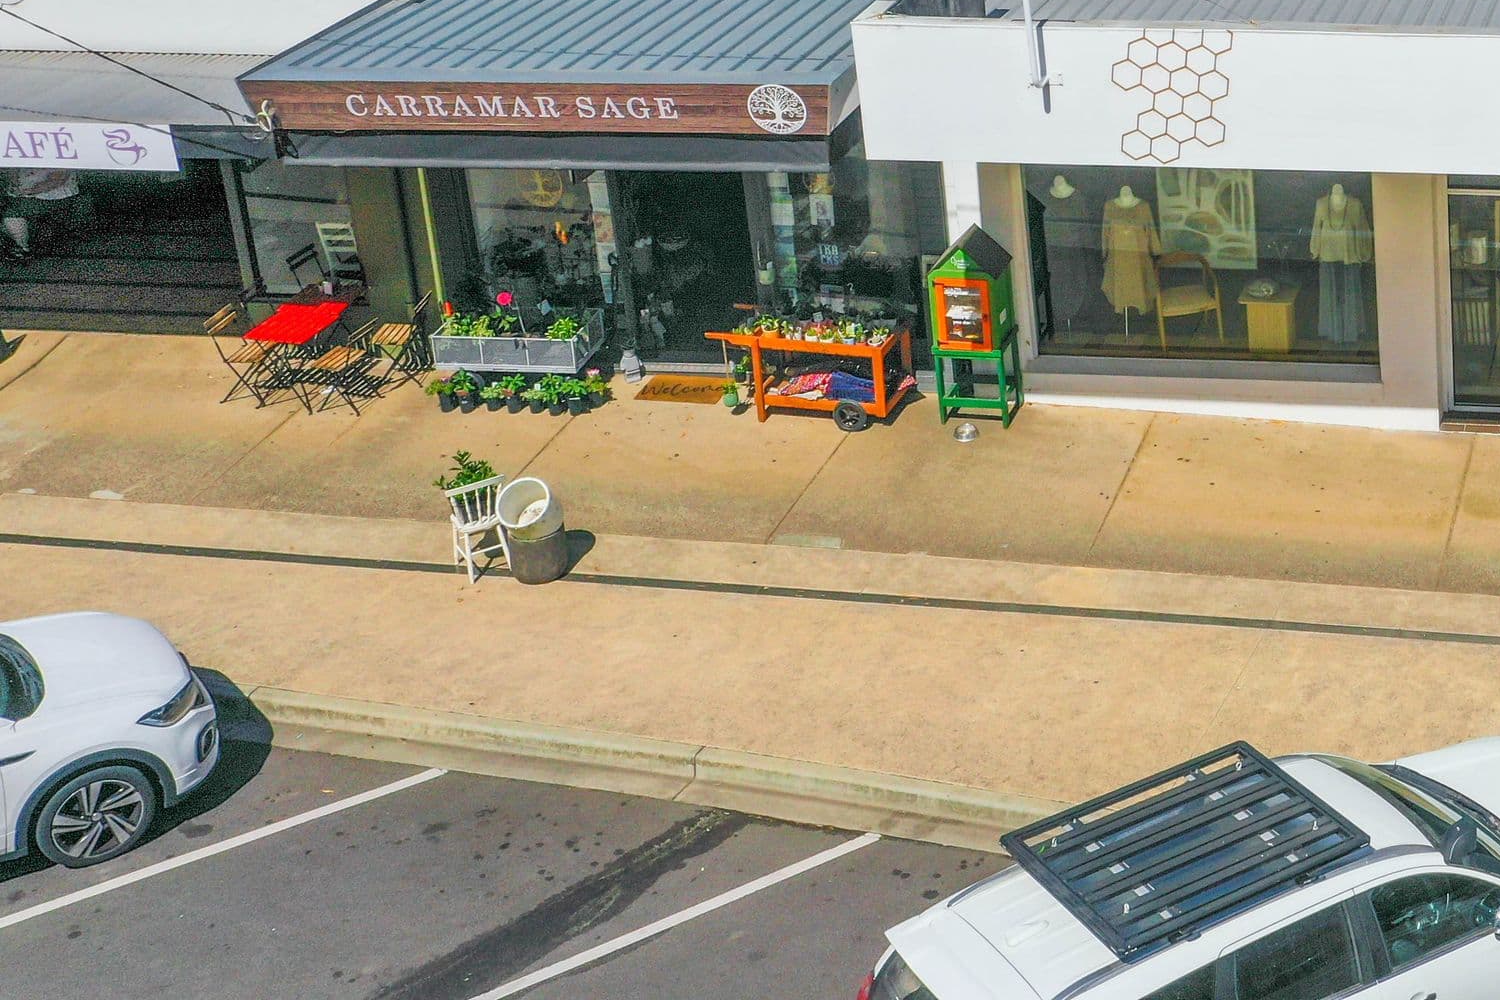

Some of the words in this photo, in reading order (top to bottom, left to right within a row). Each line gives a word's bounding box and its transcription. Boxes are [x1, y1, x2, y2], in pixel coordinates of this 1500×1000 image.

[345, 94, 561, 118] CARRAMAR
[575, 96, 679, 120] SAGE
[2, 126, 79, 160] AFÉ
